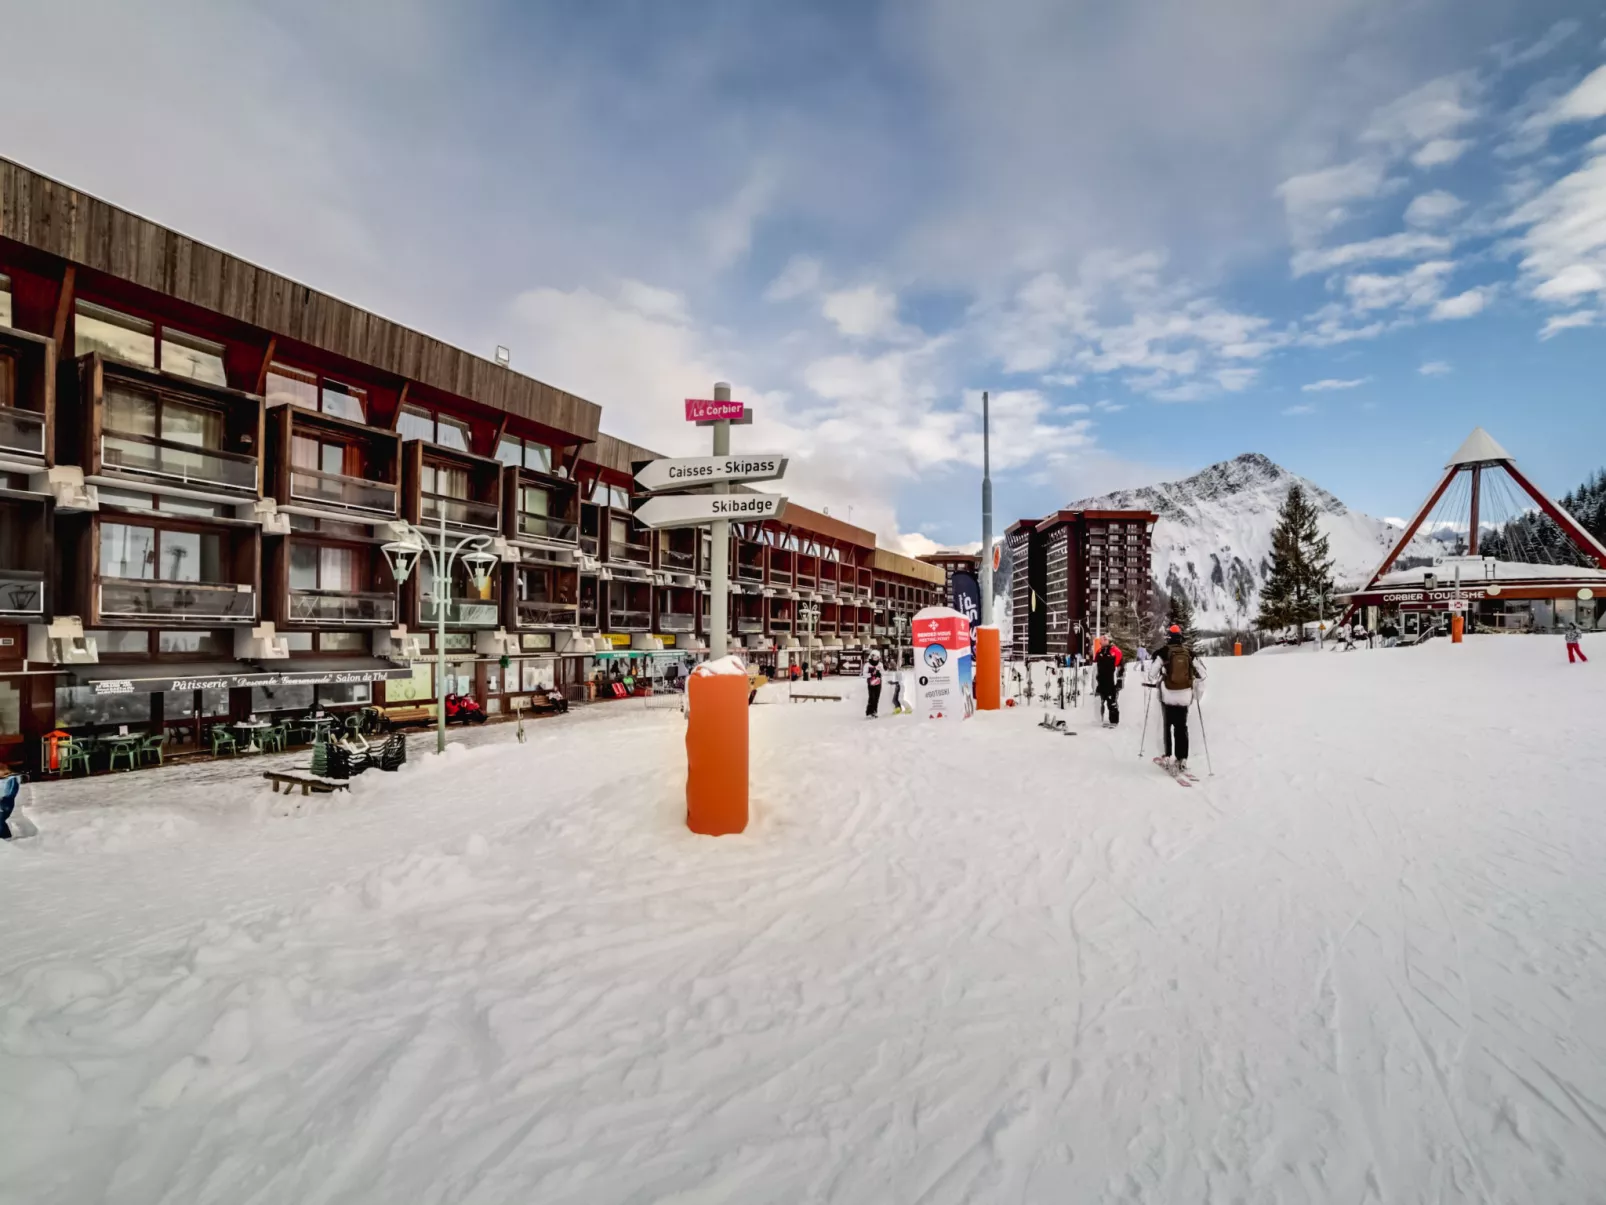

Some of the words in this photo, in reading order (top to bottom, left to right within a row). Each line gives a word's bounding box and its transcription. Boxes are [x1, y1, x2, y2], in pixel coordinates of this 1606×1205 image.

[693, 407, 704, 417] Le
[706, 403, 742, 415] Corbier
[669, 464, 713, 478] Caisses
[725, 460, 774, 475] Skipass
[712, 498, 772, 513] Skibadge
[1383, 592, 1424, 602] CORBIER
[171, 679, 228, 691] Pâtisserie
[335, 672, 361, 683] Salon
[362, 672, 372, 681] de
